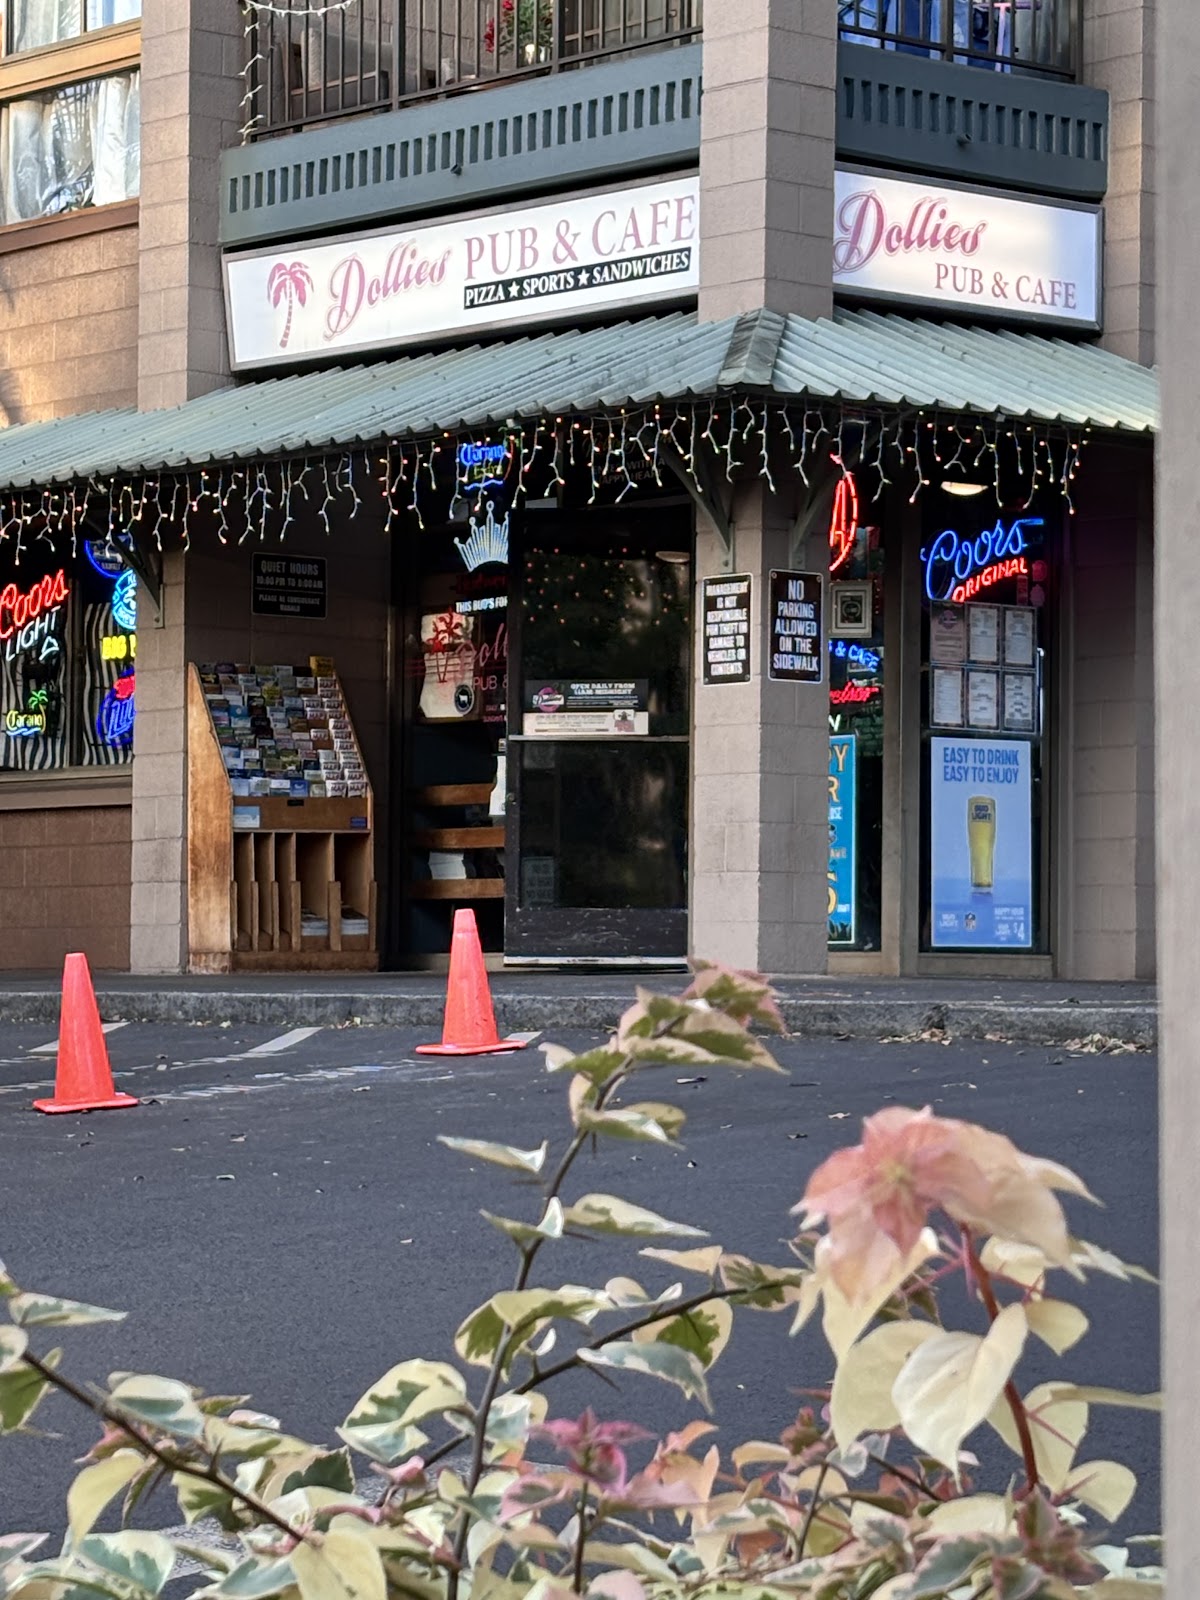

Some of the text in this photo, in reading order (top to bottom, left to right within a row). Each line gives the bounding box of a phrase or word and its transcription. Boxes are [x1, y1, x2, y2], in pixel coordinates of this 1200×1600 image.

[833, 189, 989, 275] Dollies
[323, 195, 695, 341] Dollies PUB & CAFE
[465, 251, 690, 307] PIZZA SPORTS SANDWICHES
[935, 263, 1077, 310] PUB & CAFE
[261, 560, 318, 575] QUIET HOURS
[921, 518, 1044, 600] Coors
[788, 579, 805, 600] NO
[951, 556, 1028, 603] ORIGINAL
[0, 569, 70, 638] Coors
[455, 600, 472, 613] THIS
[778, 601, 814, 619] PARKING
[6, 605, 61, 661] LIGHT
[774, 618, 817, 636] ALLOWED
[102, 635, 127, 660] BIG
[779, 636, 792, 652] ON
[794, 637, 812, 653] THE
[773, 653, 819, 671] SIDEWALK
[848, 645, 880, 673] CAFE
[474, 675, 497, 691] PUB
[943, 747, 1020, 766] EASY TO DRINK
[943, 765, 1019, 784] EASY TO ENJOY
